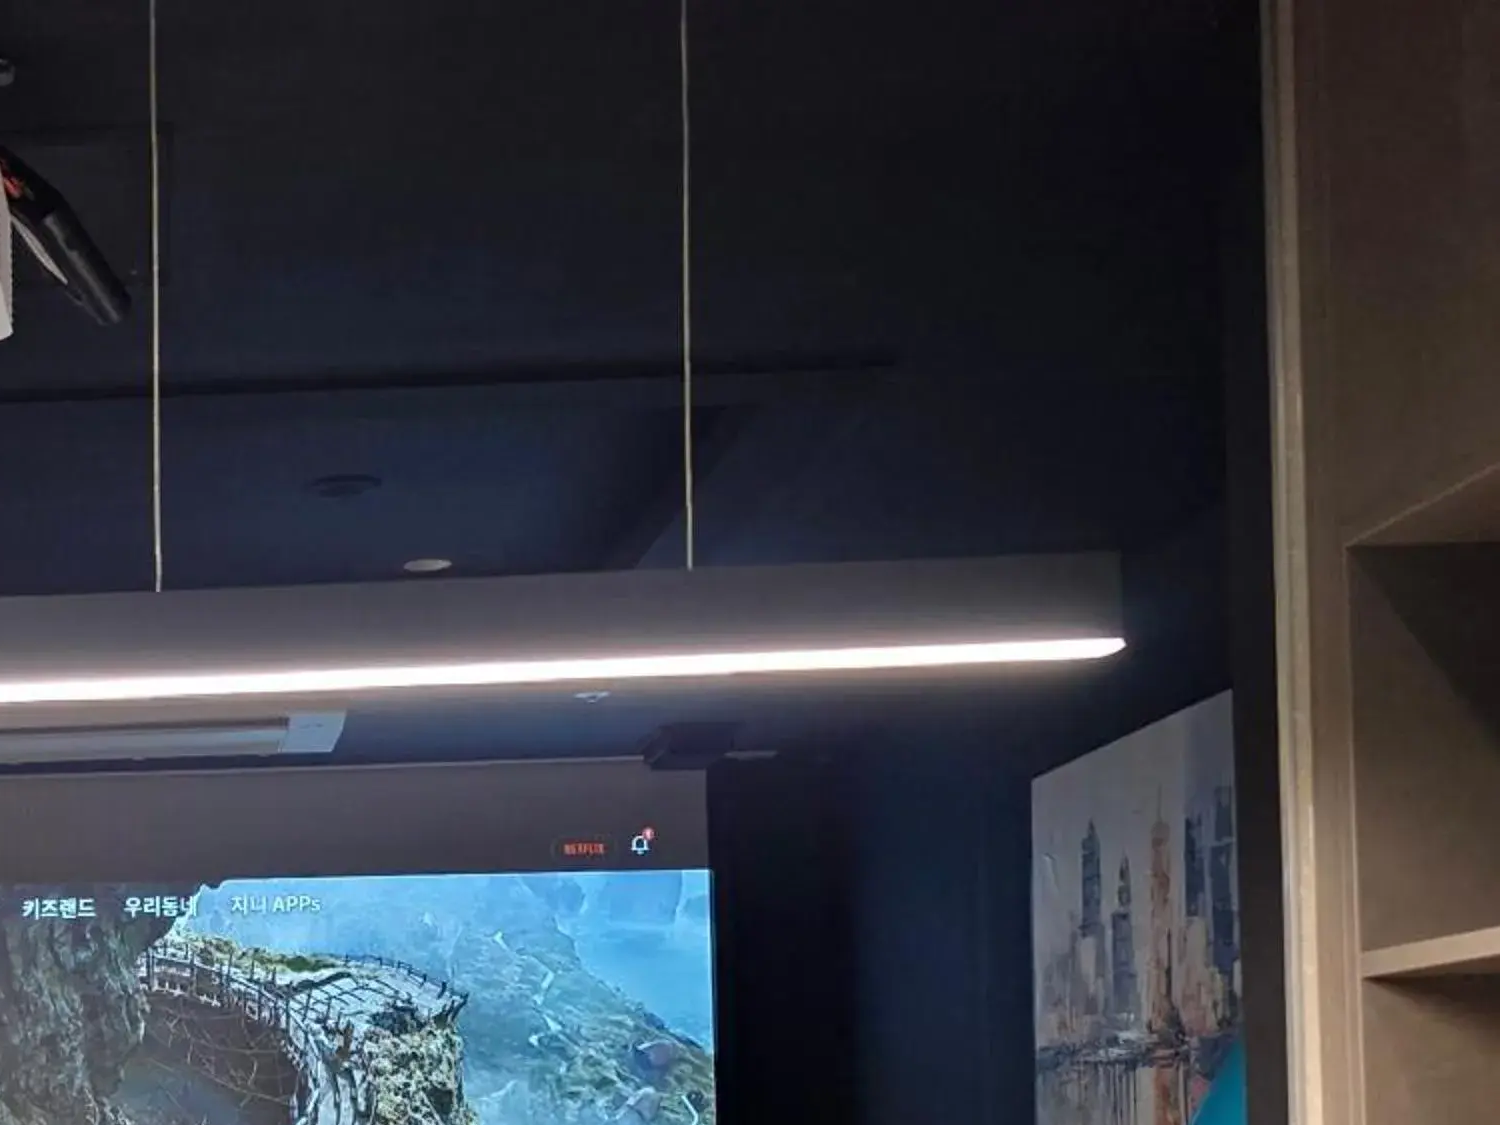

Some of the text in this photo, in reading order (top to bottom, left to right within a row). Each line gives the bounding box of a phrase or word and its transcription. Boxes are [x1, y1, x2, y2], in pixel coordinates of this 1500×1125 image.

[22, 897, 96, 919] 키즈랜드
[123, 896, 198, 917] 우리동네
[231, 895, 267, 914] 지니
